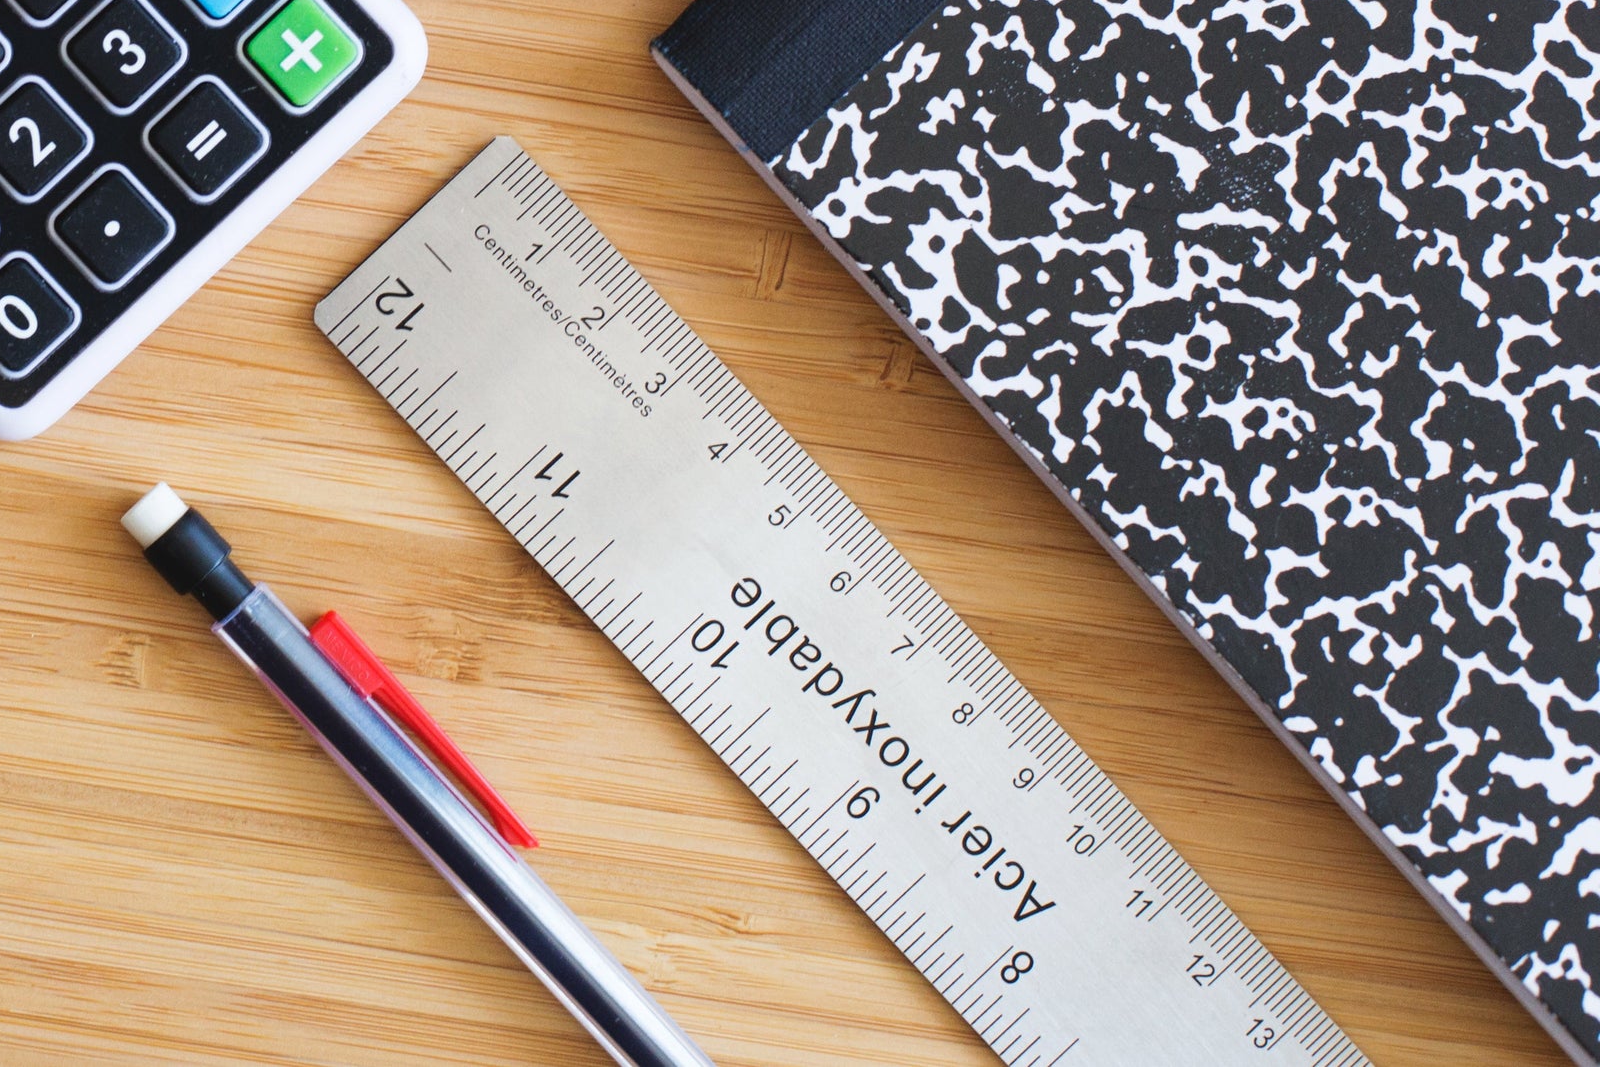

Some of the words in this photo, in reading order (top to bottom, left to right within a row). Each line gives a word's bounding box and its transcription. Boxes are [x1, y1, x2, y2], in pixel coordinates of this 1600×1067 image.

[102, 29, 147, 75] 3
[280, 28, 324, 73] +
[8, 117, 57, 167] 2
[186, 119, 227, 161] =
[524, 242, 544, 262] 1
[375, 277, 425, 332] 12
[580, 306, 606, 331] 2
[644, 372, 667, 395] 3
[707, 442, 729, 461] 4
[534, 451, 581, 499] 11
[767, 504, 792, 526] 5
[829, 571, 852, 593] 6
[691, 619, 740, 669] 10
[890, 634, 915, 655] 7
[730, 576, 948, 816] inoxydable
[951, 702, 974, 725] 8
[1012, 767, 1035, 789] 9
[846, 786, 881, 821] 9
[1065, 824, 1096, 856] 10
[940, 810, 1057, 923] Acier
[1125, 889, 1154, 919] 11
[1000, 951, 1035, 985] 8
[1185, 954, 1216, 987] 12
[1245, 1018, 1275, 1049] 13
